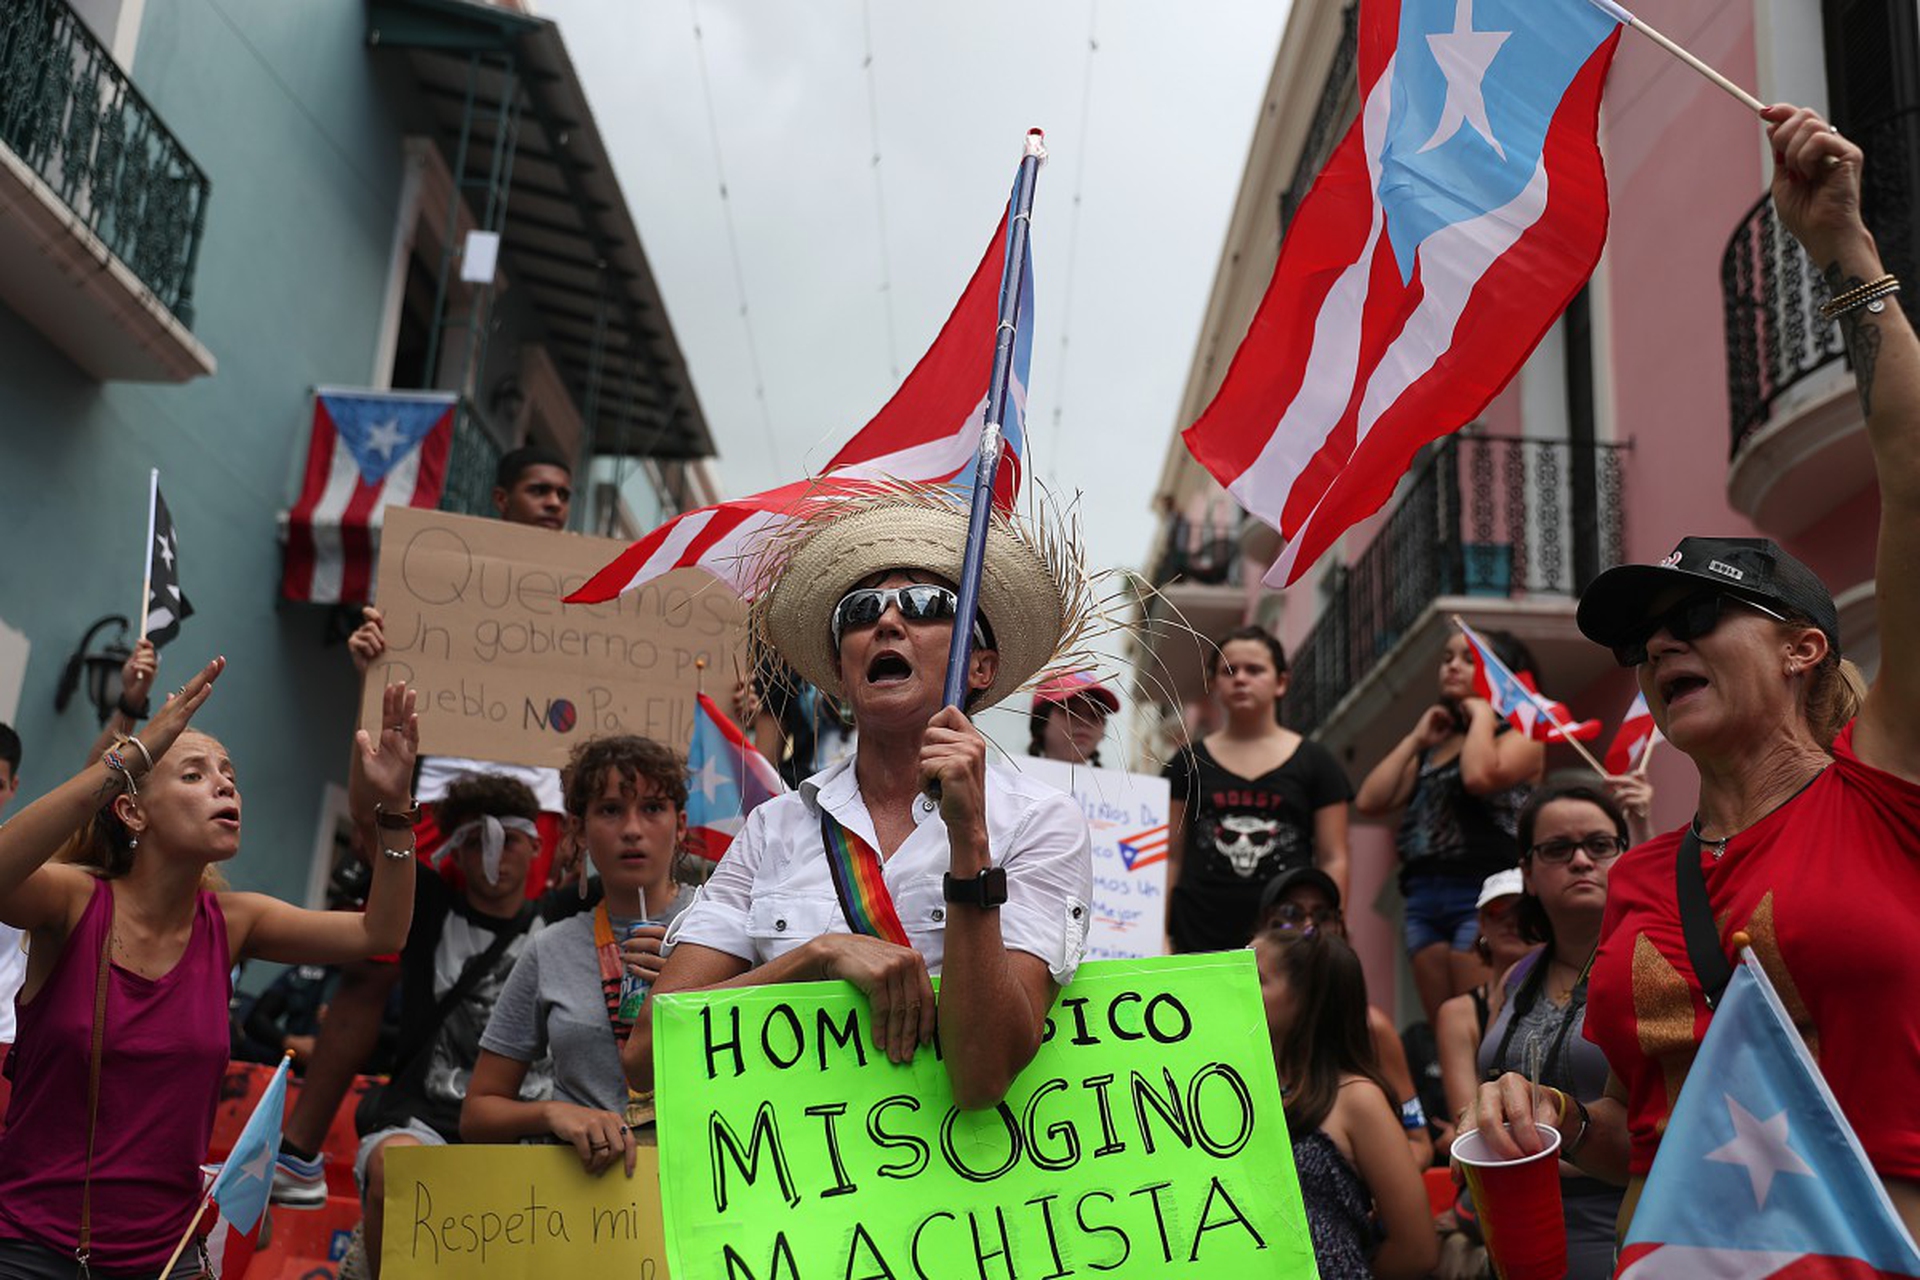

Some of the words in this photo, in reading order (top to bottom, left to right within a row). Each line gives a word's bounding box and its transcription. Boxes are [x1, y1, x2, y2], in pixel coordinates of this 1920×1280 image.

[384, 611, 450, 660] Un
[474, 618, 659, 663] gobierno
[699, 992, 1192, 1079] HOMICO
[707, 1061, 1255, 1212] MISOGINO
[412, 1180, 570, 1264] Respeta
[593, 1201, 638, 1244] mi
